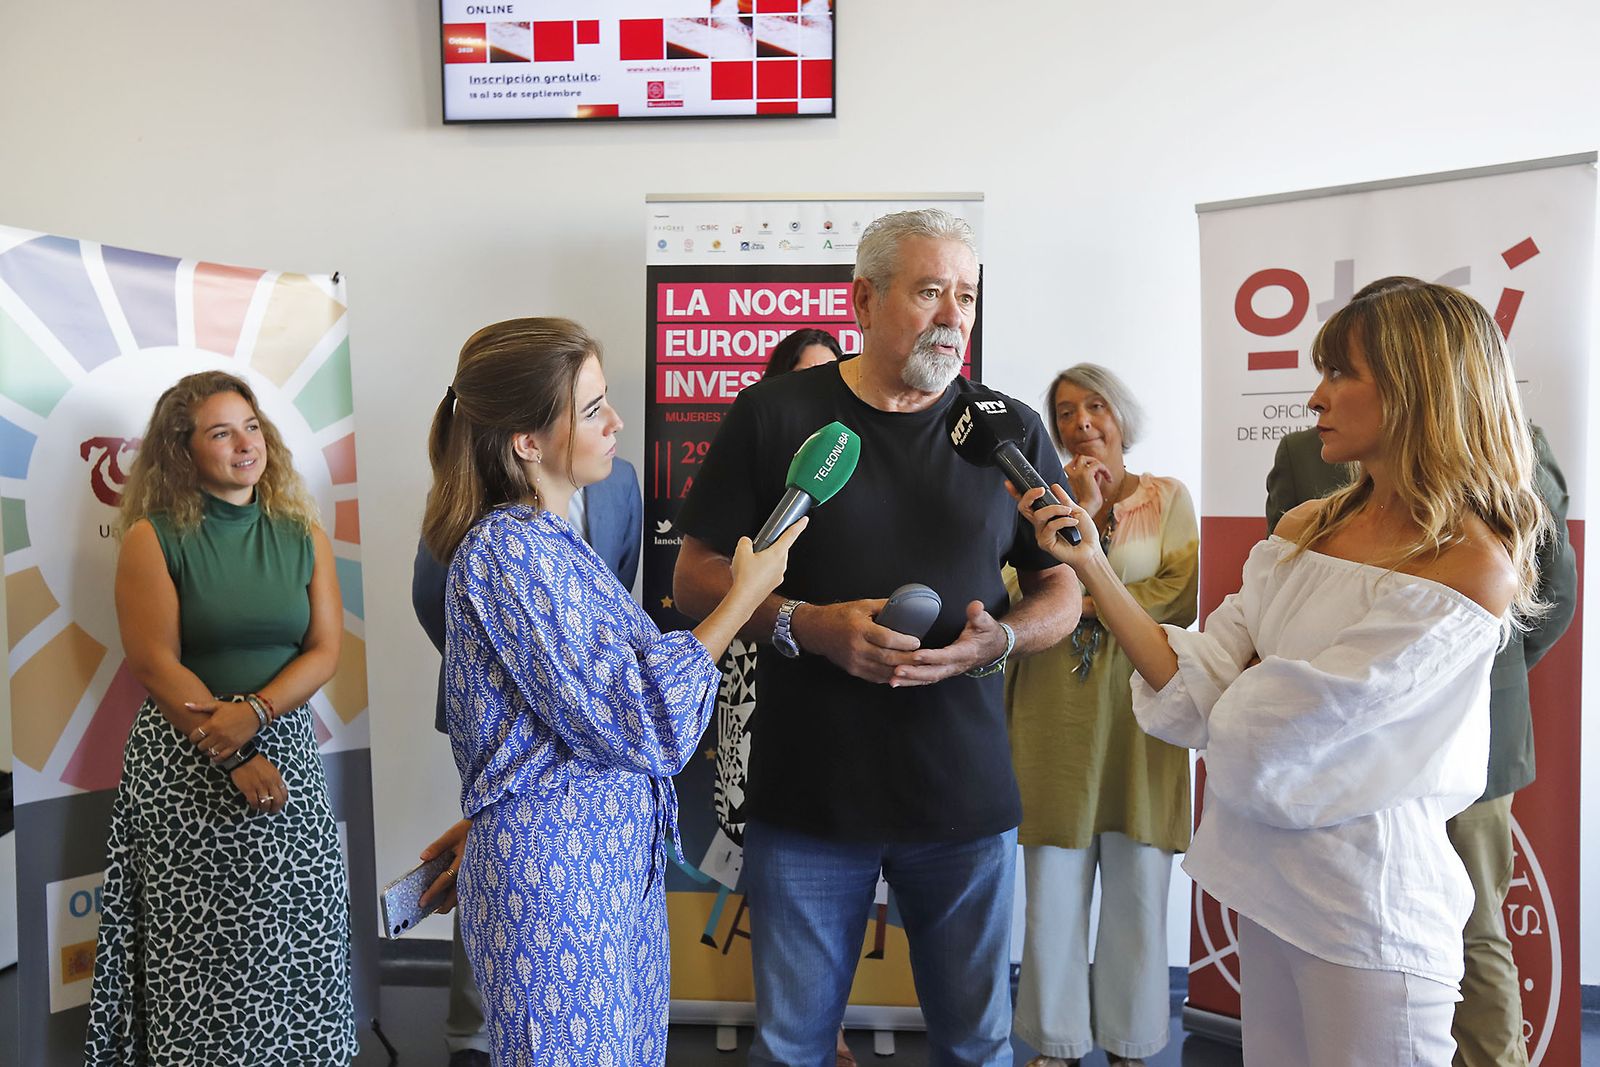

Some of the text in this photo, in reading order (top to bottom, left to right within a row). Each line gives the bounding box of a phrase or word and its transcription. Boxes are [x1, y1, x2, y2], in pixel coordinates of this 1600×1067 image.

[466, 5, 514, 15] ONLINE
[469, 73, 601, 85] Inscripción gratuita:
[480, 91, 490, 99] al
[505, 90, 518, 98] de
[521, 90, 582, 99] septiembre
[665, 289, 848, 316] LA NOCHE
[665, 329, 864, 357] EUROP D
[665, 370, 767, 398] INVES
[974, 400, 1006, 411] HTV
[665, 412, 721, 422] MUJERES
[950, 405, 972, 446] HTV
[1237, 427, 1258, 441] DE
[813, 431, 850, 483] TELEONUBA
